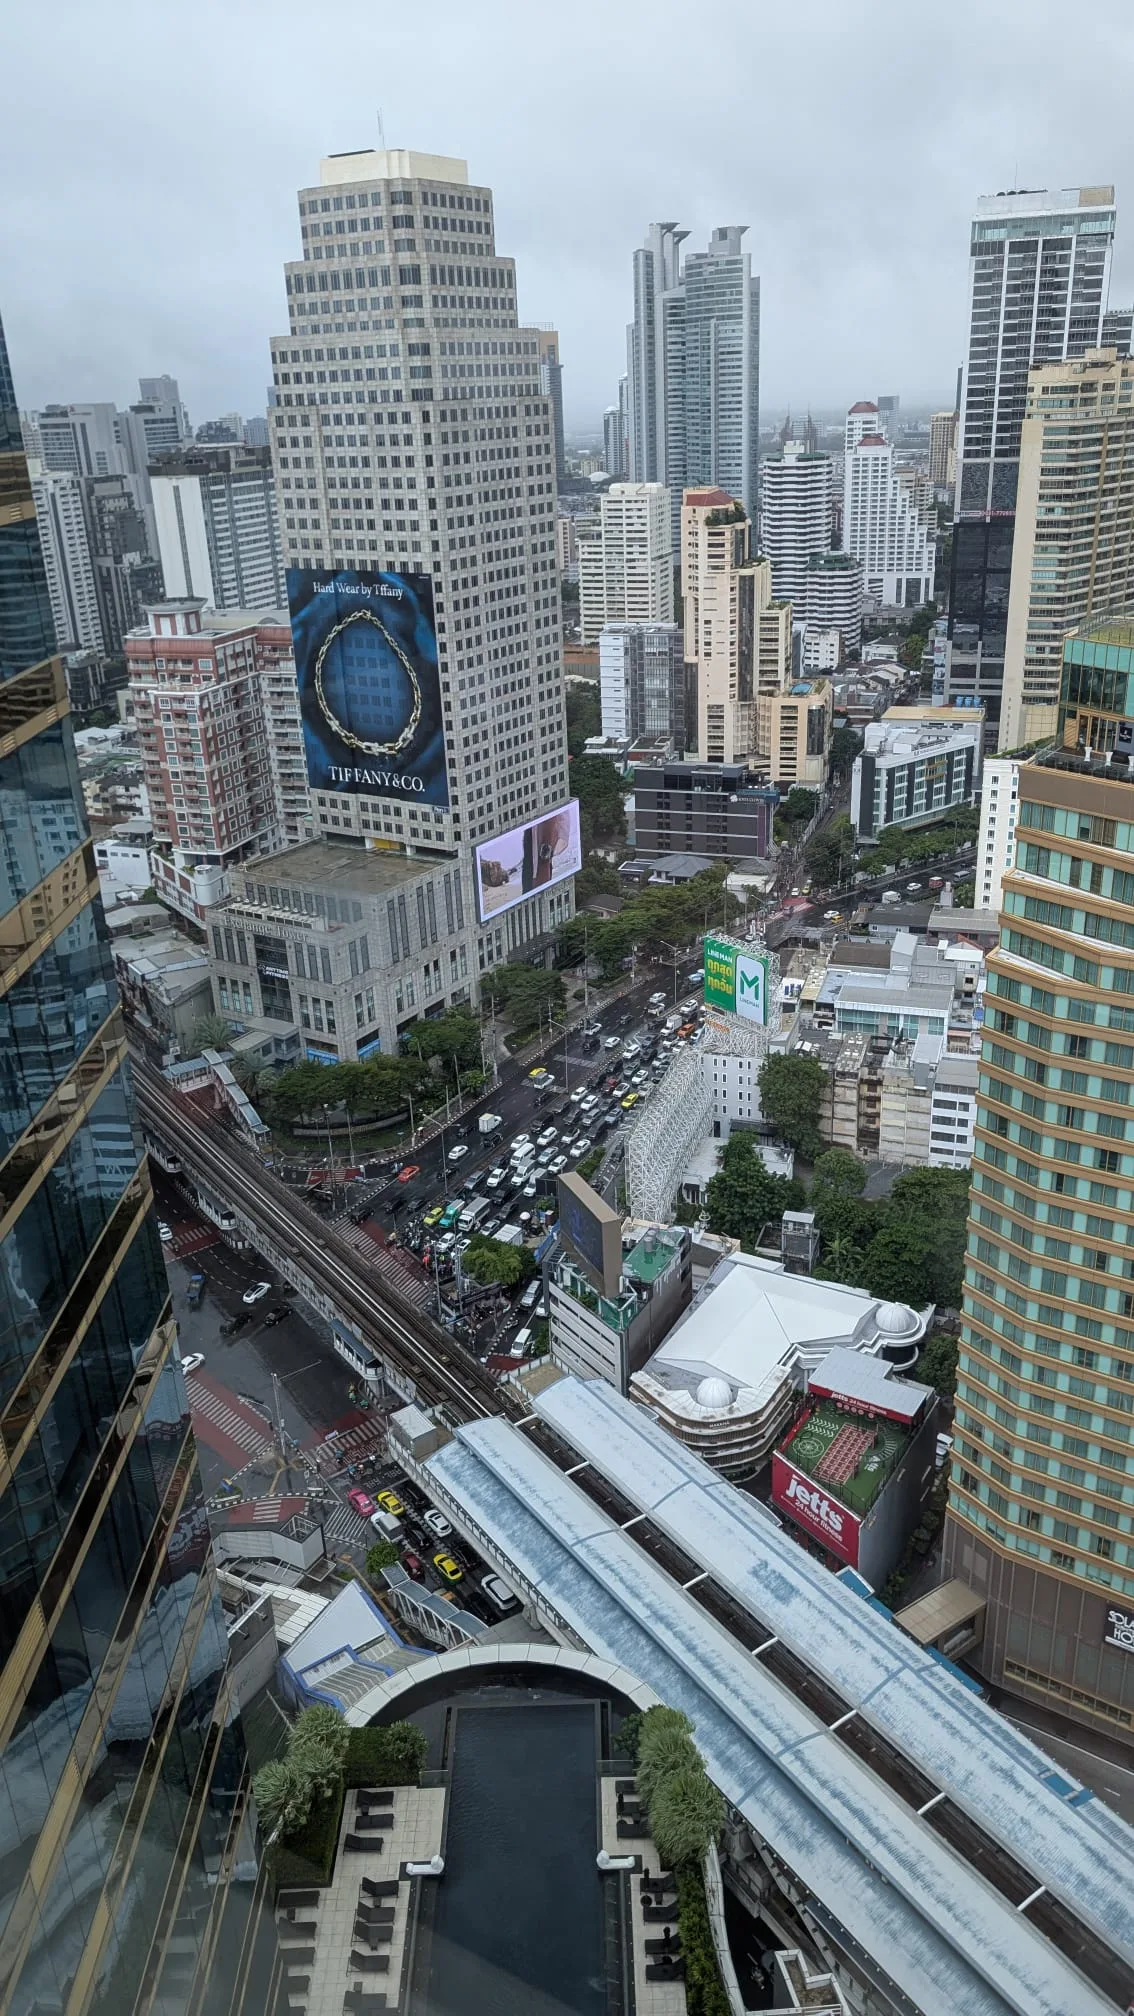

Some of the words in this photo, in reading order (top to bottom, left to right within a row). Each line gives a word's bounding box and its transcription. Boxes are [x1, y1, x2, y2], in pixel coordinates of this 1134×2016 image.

[313, 582, 335, 593] Hard
[336, 582, 360, 595] Wear
[361, 584, 372, 598] by
[785, 1474, 844, 1532] jetts
[795, 1499, 804, 1510] 24
[804, 1506, 820, 1522] hour
[820, 1520, 843, 1542] fitness
